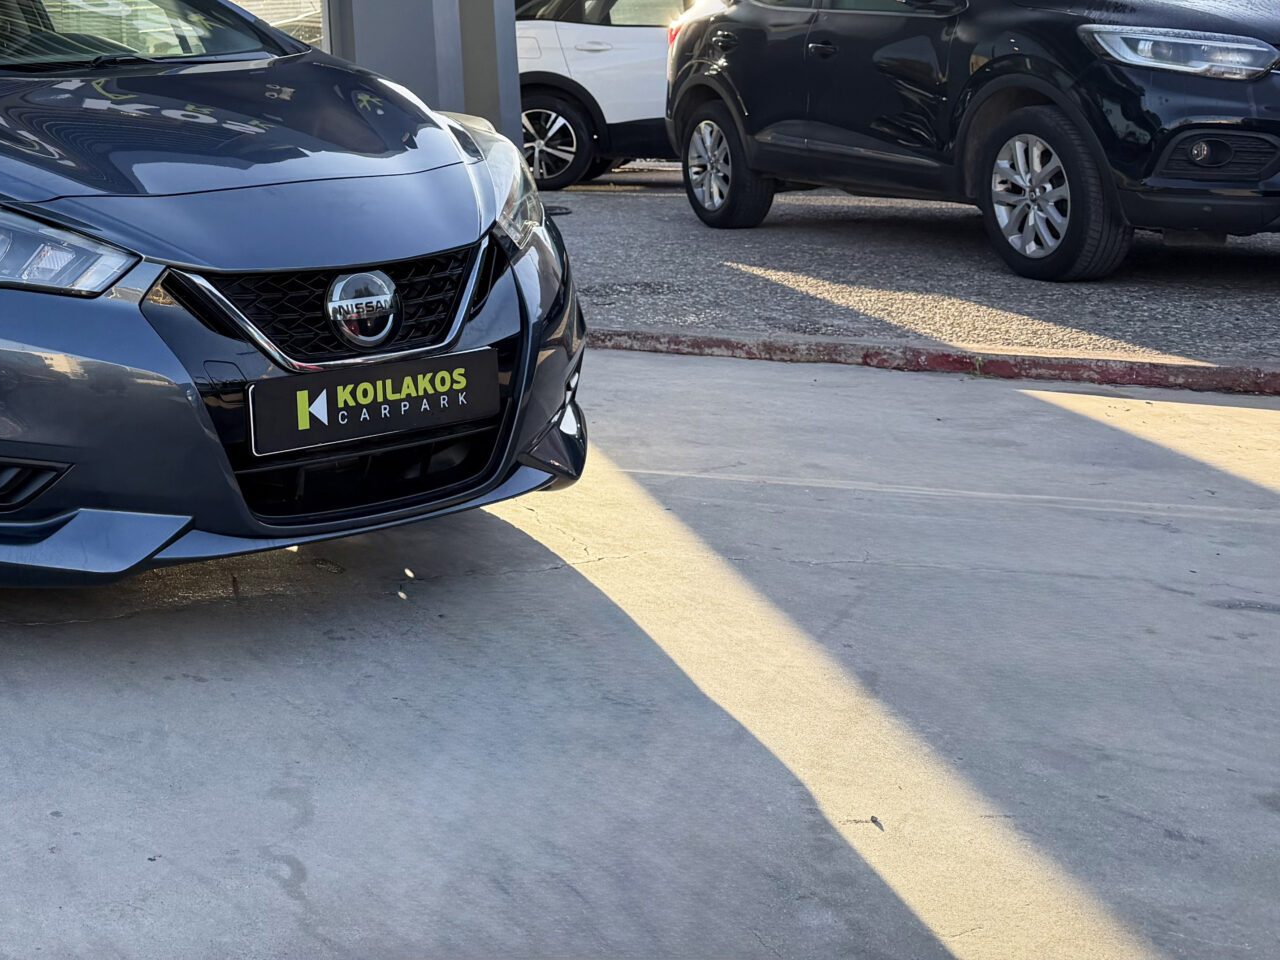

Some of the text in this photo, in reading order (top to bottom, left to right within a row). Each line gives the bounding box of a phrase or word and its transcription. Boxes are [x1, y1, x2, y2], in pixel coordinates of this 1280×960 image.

[337, 298, 395, 316] NISSAN
[336, 367, 468, 409] KOILAKOS
[338, 391, 468, 425] CARPARK
